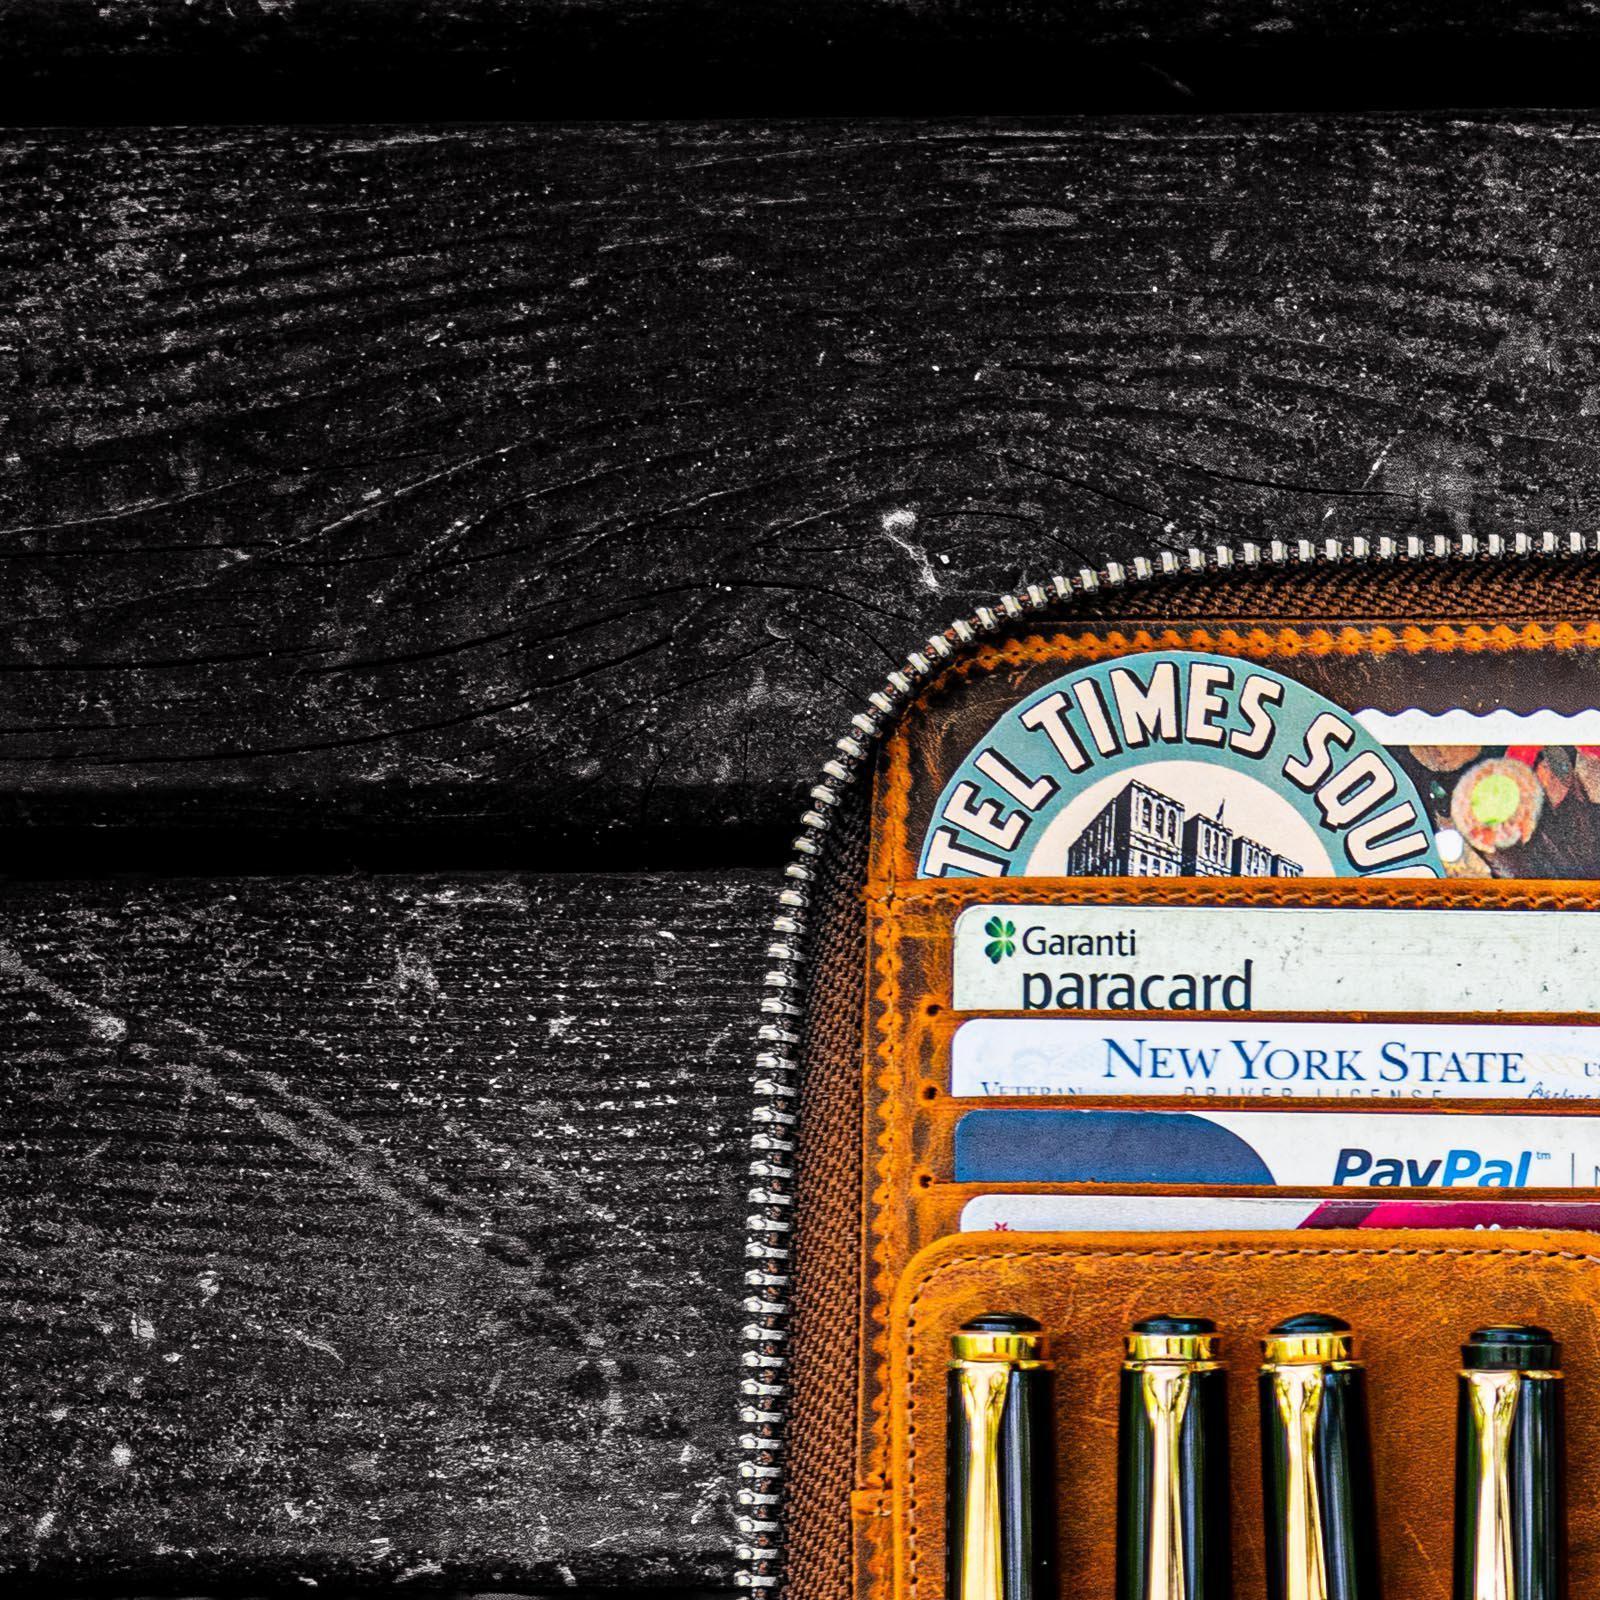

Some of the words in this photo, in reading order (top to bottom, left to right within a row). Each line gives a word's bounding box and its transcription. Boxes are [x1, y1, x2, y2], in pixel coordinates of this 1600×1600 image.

[1020, 661, 1285, 775] TIMES
[1283, 712, 1439, 877] SQU
[1021, 926, 1136, 957] Garanti
[1022, 959, 1253, 1010] paracard
[1102, 1039, 1220, 1079] NEW
[1229, 1040, 1365, 1081] YORK
[1379, 1041, 1526, 1084] STATE
